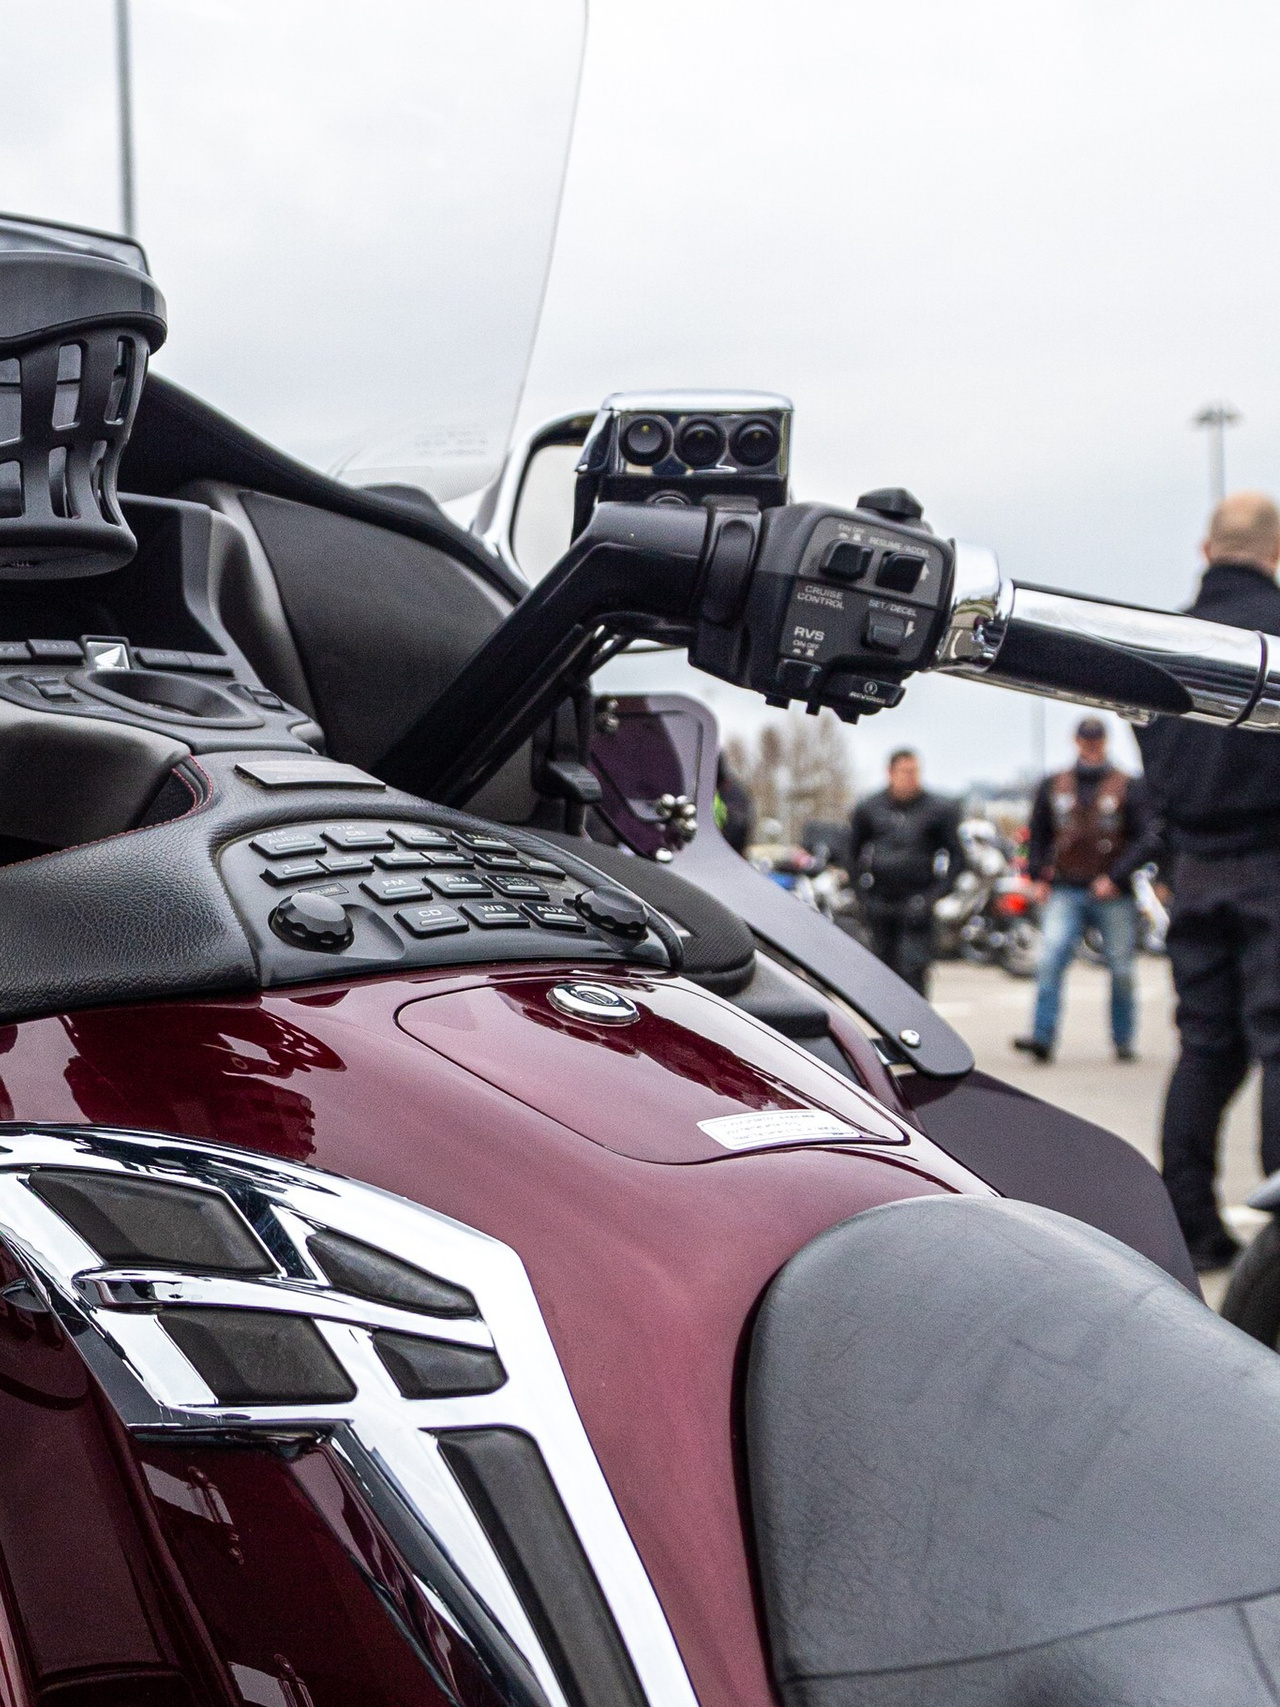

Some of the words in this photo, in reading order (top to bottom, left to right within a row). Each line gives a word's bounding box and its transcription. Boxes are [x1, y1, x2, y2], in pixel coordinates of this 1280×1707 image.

[804, 585, 844, 599] CRUISE
[796, 592, 845, 610] CONTROL
[868, 599, 917, 617] SET/DECEL
[794, 626, 825, 641] RVS
[793, 639, 806, 648] ON
[806, 642, 820, 650] OFF
[382, 879, 407, 887] FM
[418, 909, 442, 917] CD
